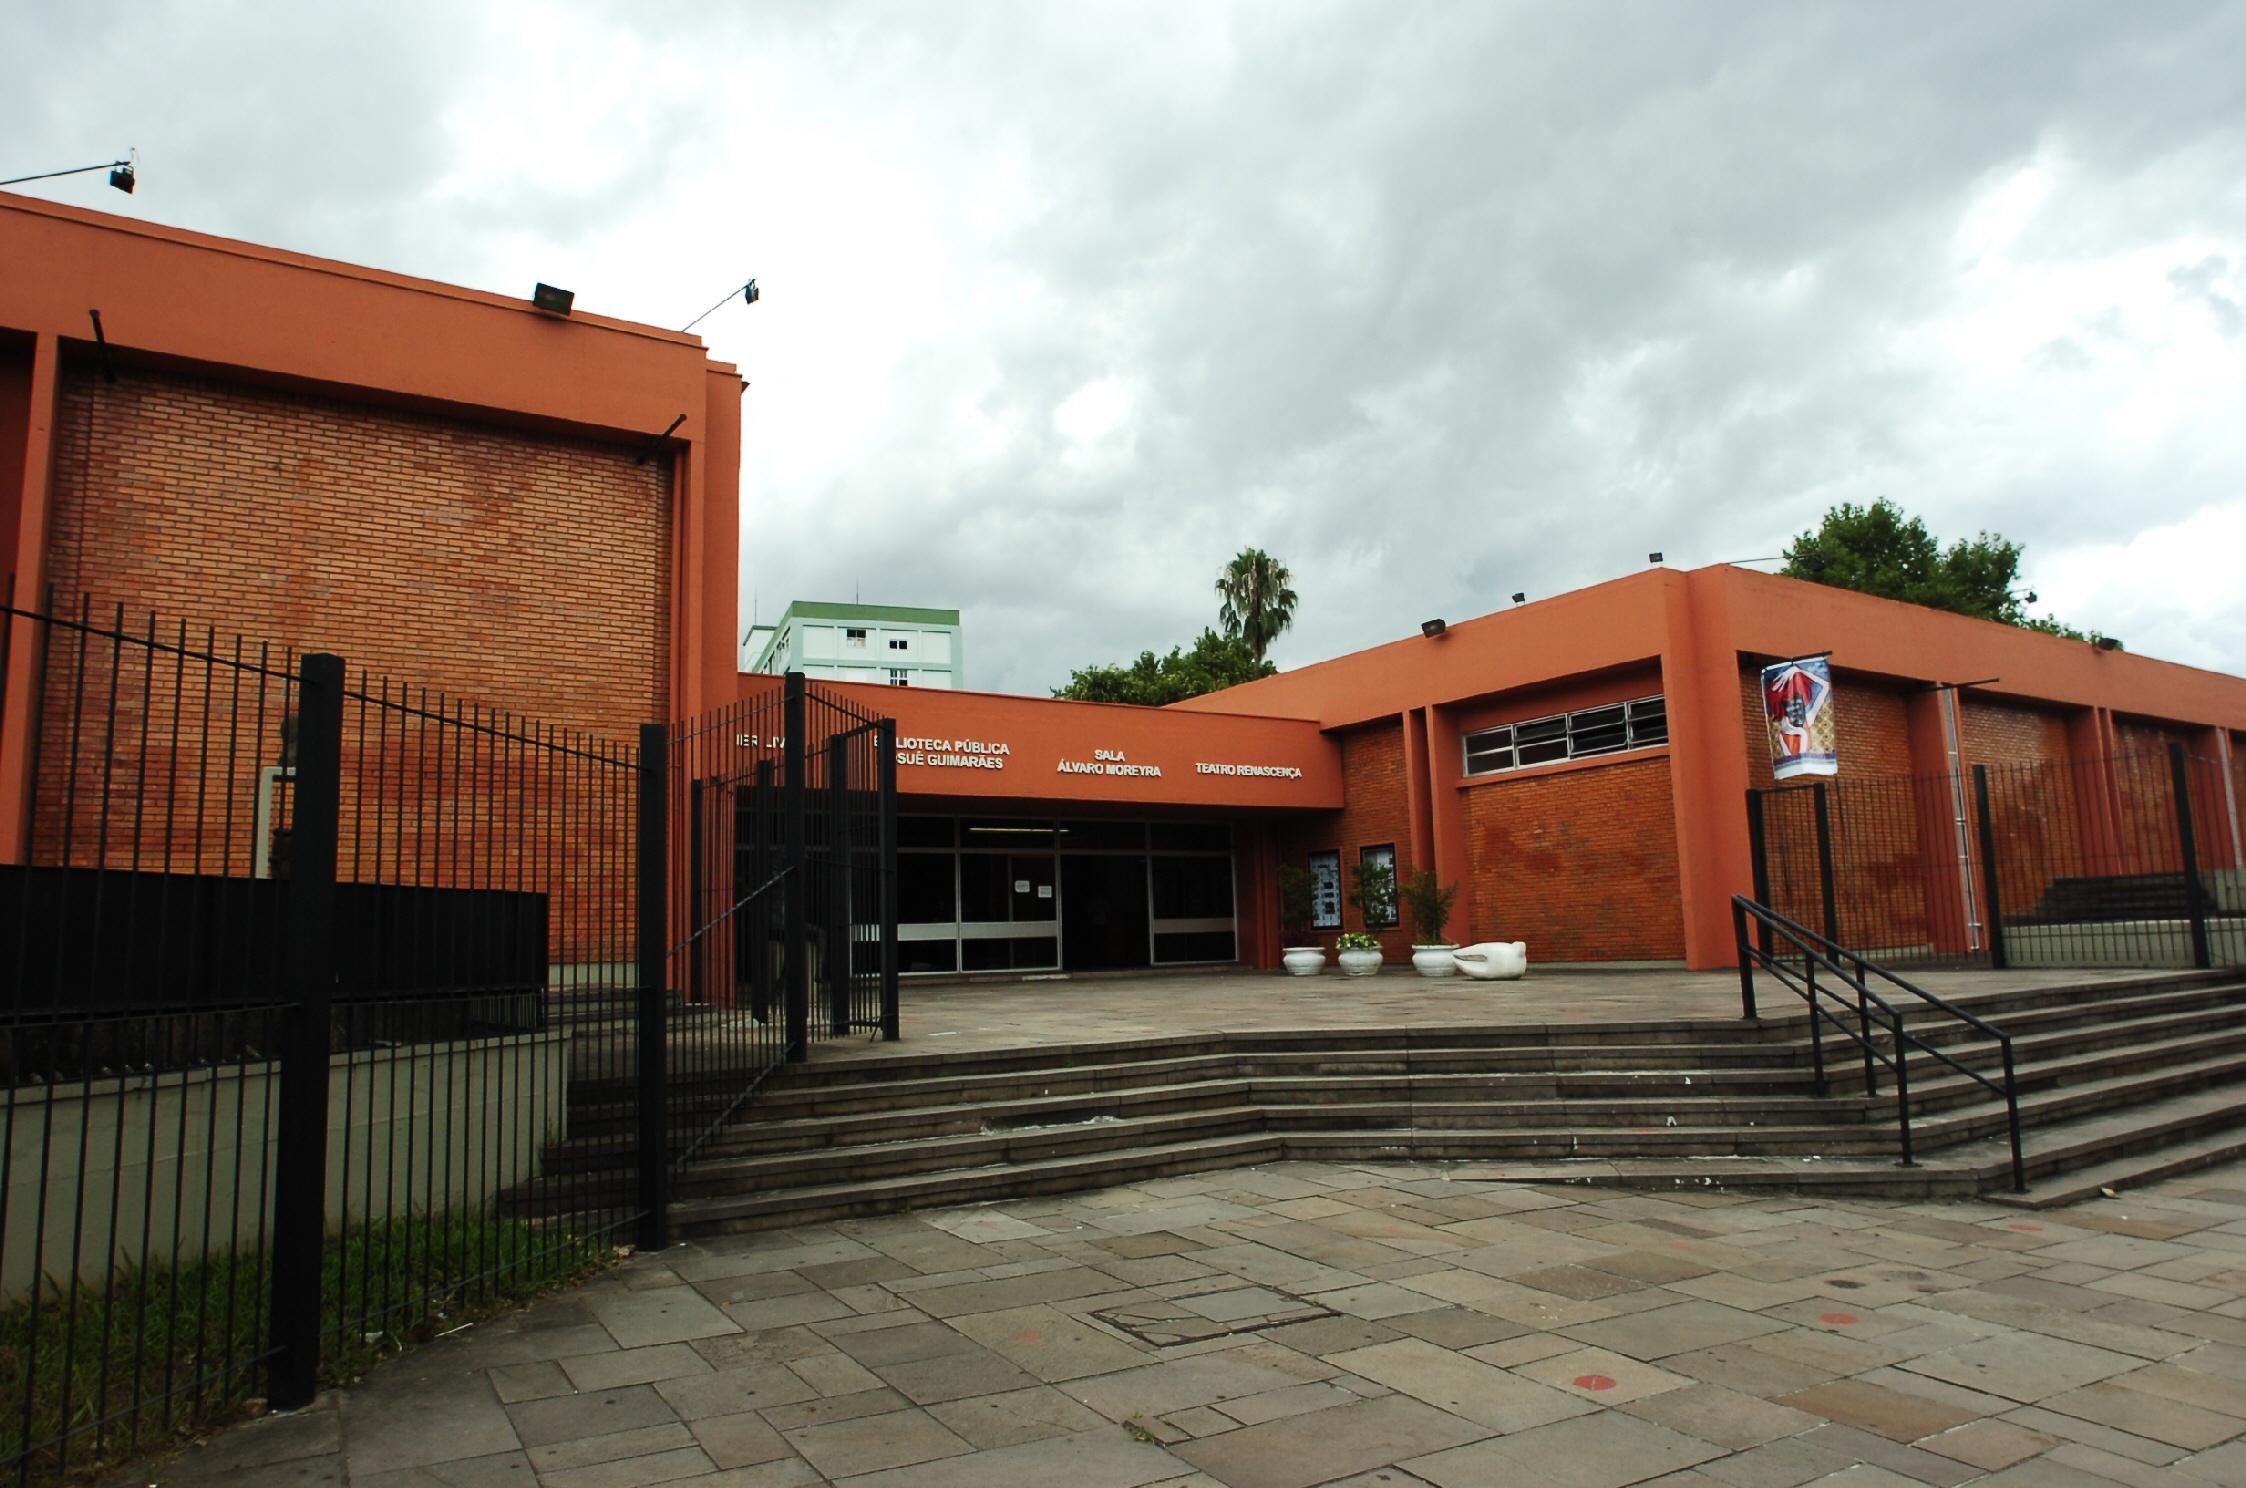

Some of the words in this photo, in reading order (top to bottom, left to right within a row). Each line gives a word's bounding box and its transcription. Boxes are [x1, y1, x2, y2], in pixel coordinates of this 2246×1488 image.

[954, 739, 1010, 755] PÚBLICA
[1094, 749, 1126, 761] SALA
[927, 754, 1004, 769] GUIMARÃES
[1057, 759, 1104, 775] ÁLVARO
[1106, 764, 1162, 776] MOREYRA
[1195, 762, 1236, 775] TEATRO
[1236, 765, 1302, 779] RENASCENÇA
